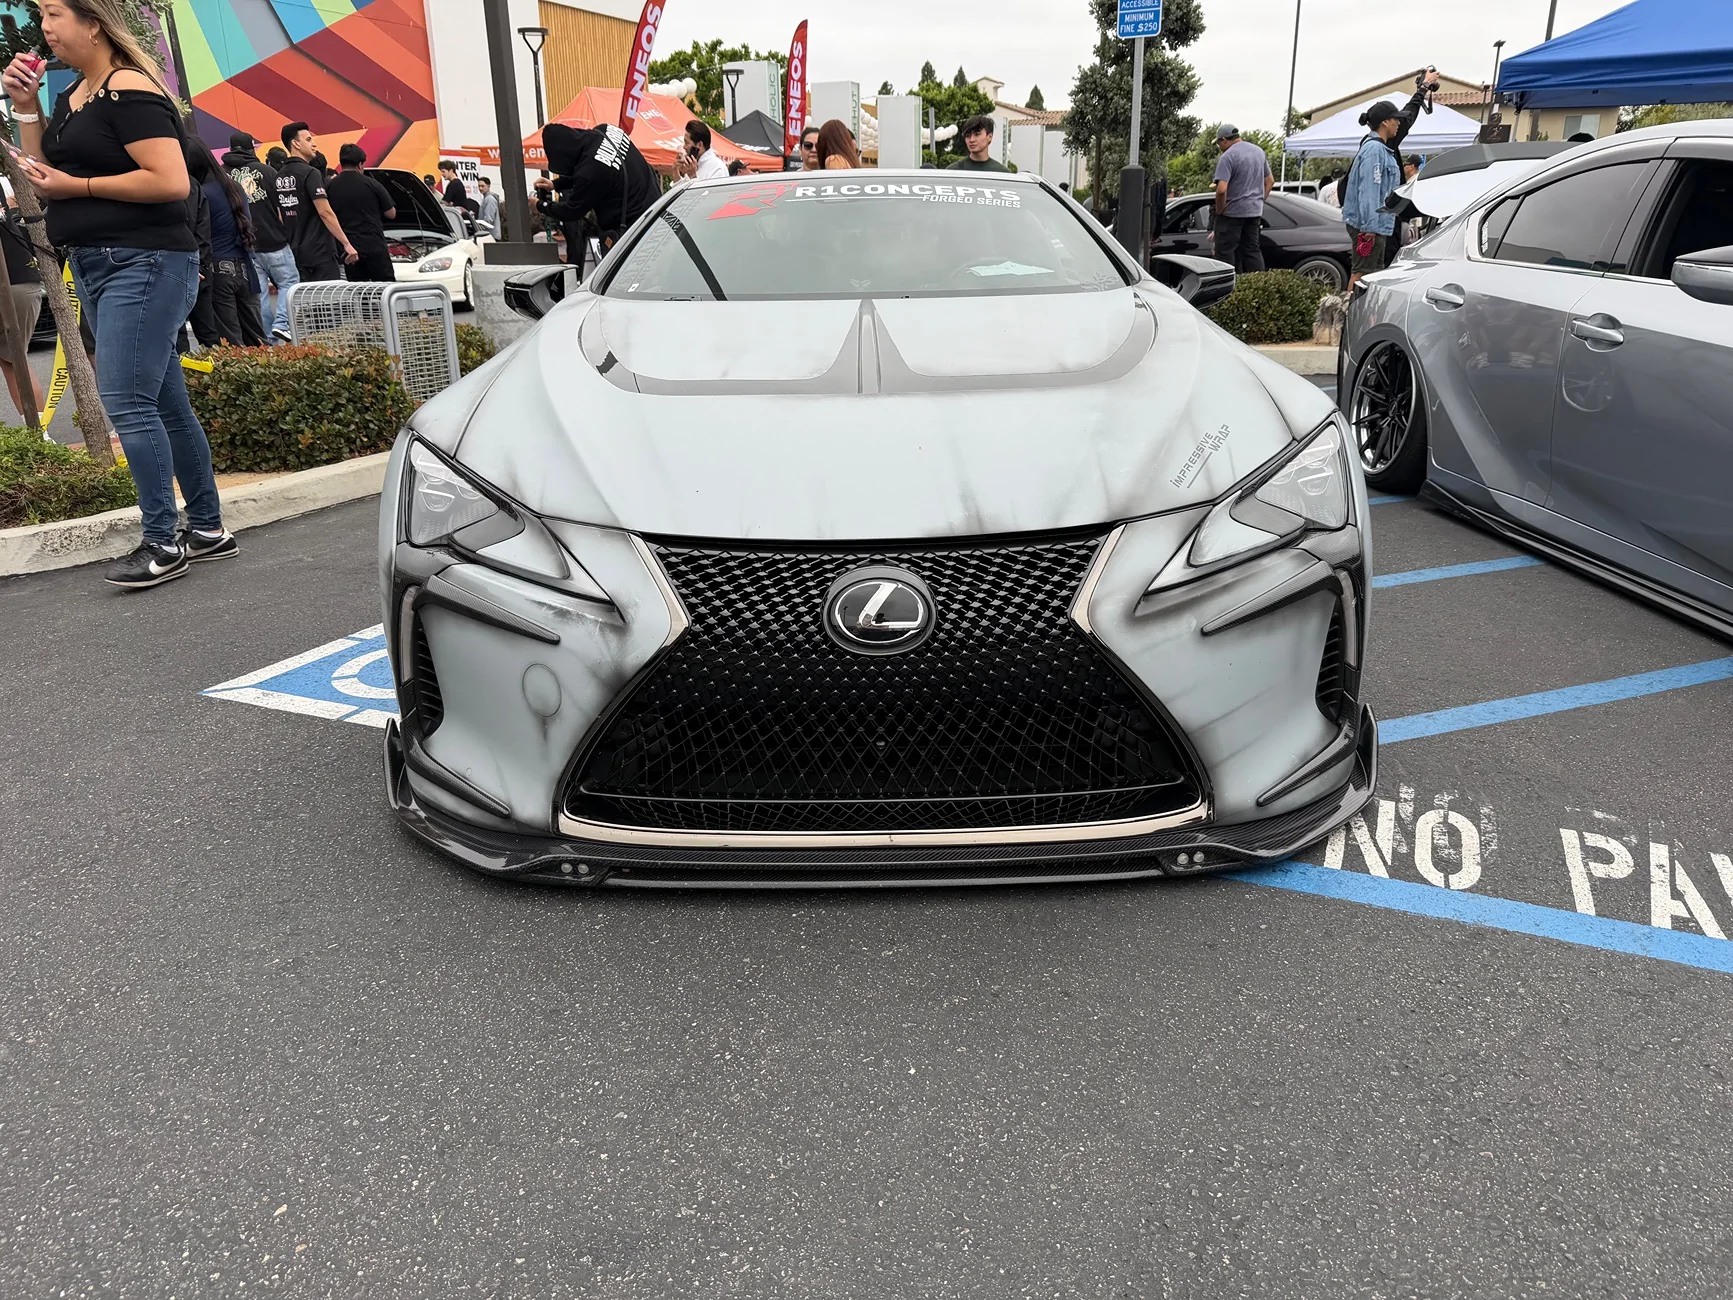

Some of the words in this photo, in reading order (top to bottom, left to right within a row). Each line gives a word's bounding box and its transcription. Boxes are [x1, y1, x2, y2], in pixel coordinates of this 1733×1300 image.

[1121, 0, 1159, 9] ACCESSIBLE
[1124, 12, 1155, 22] MINIMUM
[1120, 23, 1135, 33] FINE
[1137, 22, 1158, 32] $250
[626, 3, 661, 119] ENEOS
[789, 41, 803, 137] ENEOS
[454, 161, 477, 171] NTER
[795, 184, 1021, 201] R1CONCEPTS
[922, 194, 973, 204] FORGED
[976, 197, 1021, 208] SERIES
[48, 367, 68, 409] CAUTION
[1208, 424, 1230, 452] WRAP
[1323, 798, 1482, 890] NO
